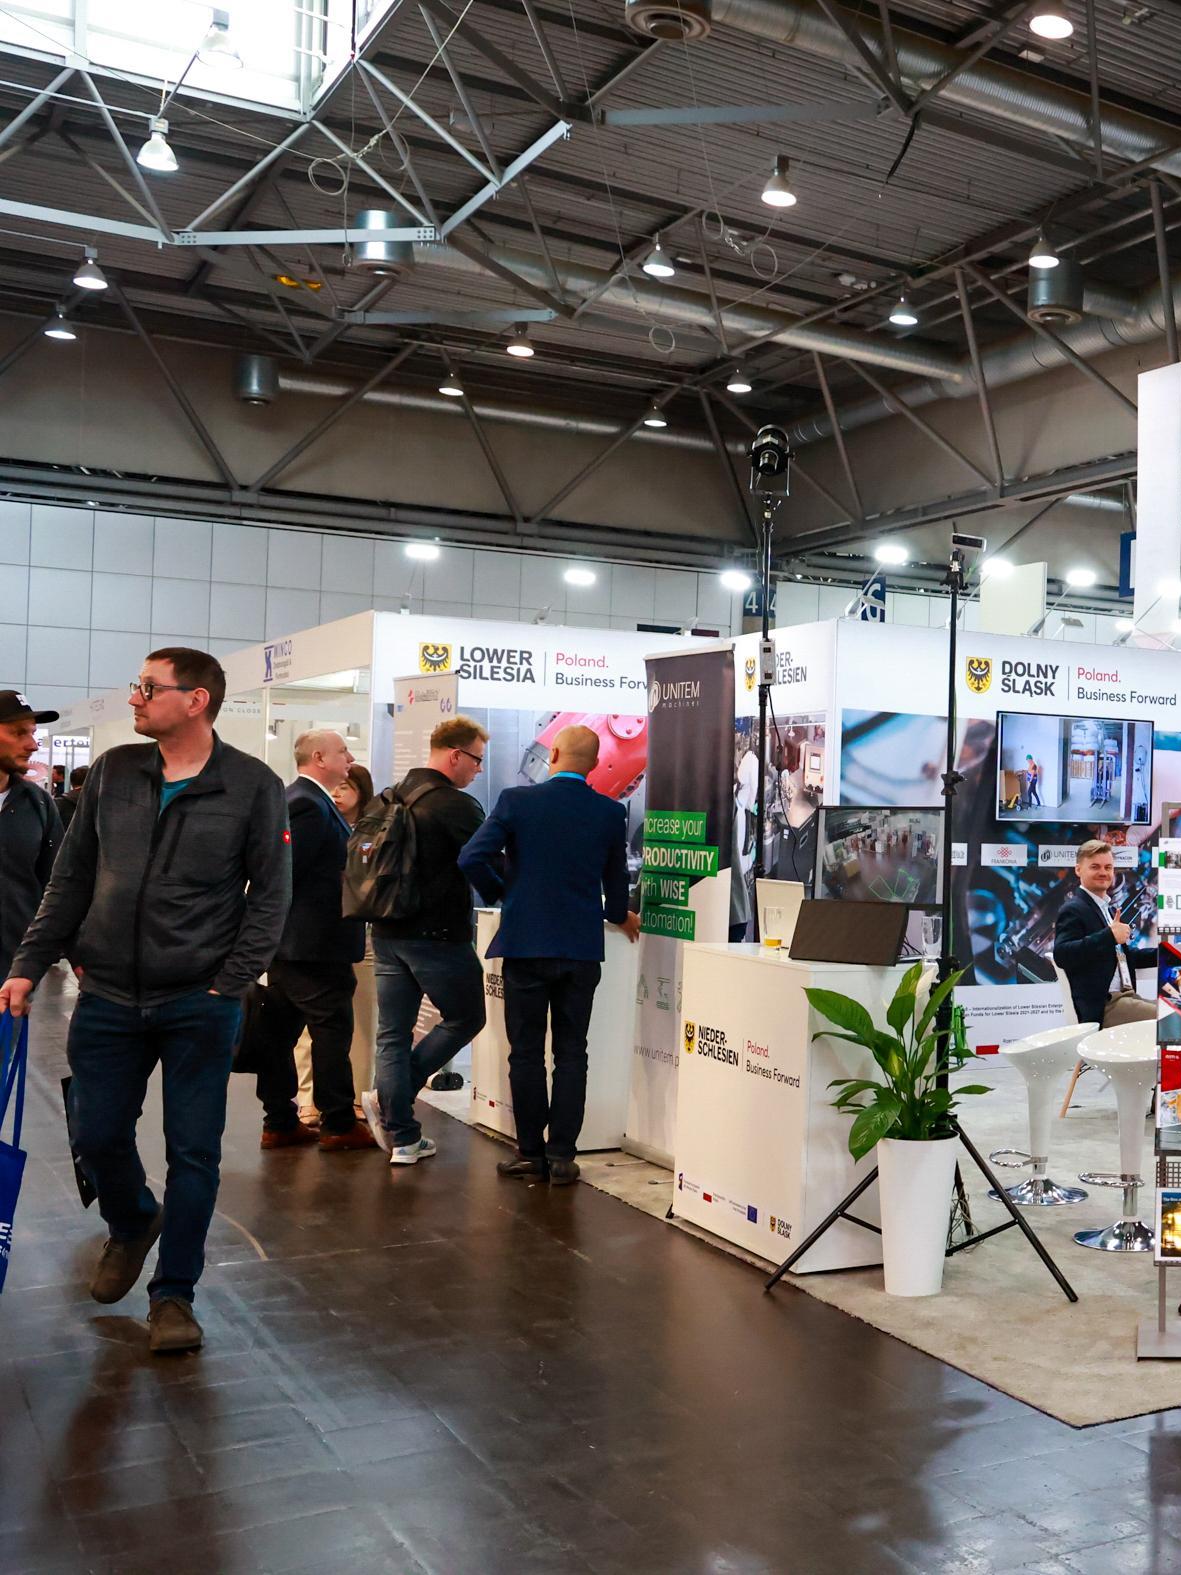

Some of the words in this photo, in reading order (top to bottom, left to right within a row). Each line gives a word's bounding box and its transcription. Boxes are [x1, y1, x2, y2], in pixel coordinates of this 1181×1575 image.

[745, 591, 758, 613] 4
[459, 646, 532, 666] LOWER
[555, 652, 609, 669] Poland.
[459, 664, 536, 683] SILESIA
[1001, 660, 1060, 680] DOLNY
[1077, 667, 1121, 683] Poland.
[555, 672, 614, 689] Business
[662, 680, 700, 700] UNITEM
[1001, 677, 1056, 697] ŚLĄSK
[1077, 687, 1127, 702] Business
[1130, 691, 1177, 706] Forward
[682, 819, 704, 840] your
[660, 879, 686, 901] WISE
[698, 1025, 727, 1046] NIEDER-
[698, 1041, 739, 1066] SCHLESIEN
[747, 1040, 770, 1058] Poland.
[746, 1060, 772, 1079] Business
[773, 1068, 800, 1088] Forward
